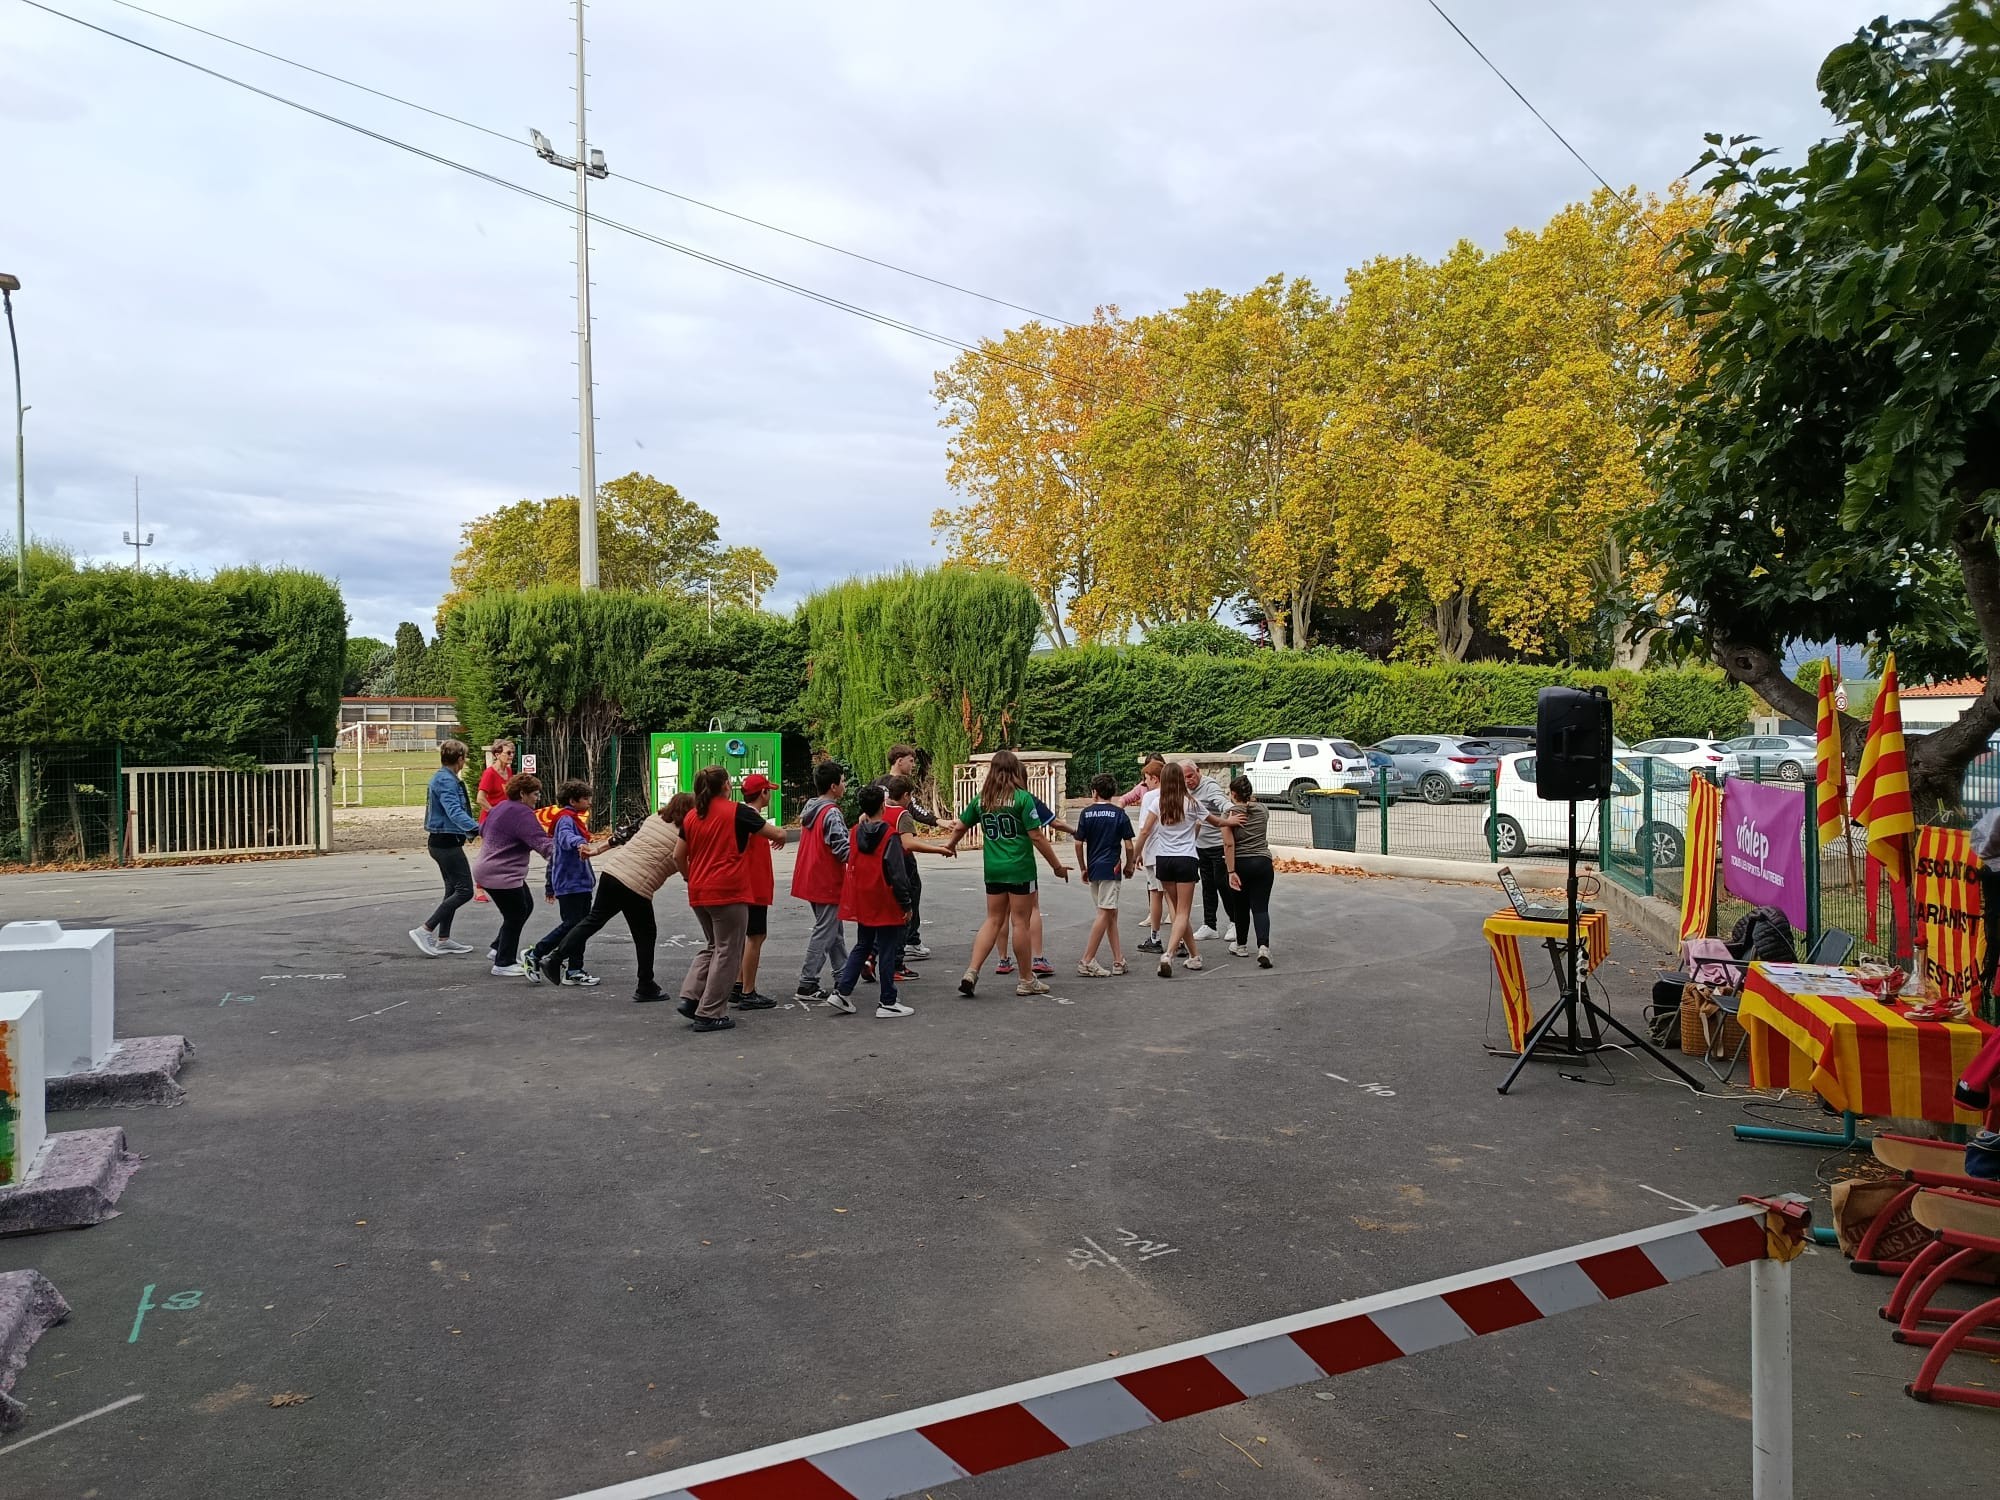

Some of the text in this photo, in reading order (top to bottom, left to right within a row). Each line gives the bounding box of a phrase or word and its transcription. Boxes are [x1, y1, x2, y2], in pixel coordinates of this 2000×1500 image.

[751, 767, 769, 775] TRIE
[981, 812, 1018, 841] 60
[1917, 902, 1984, 937] ARDANIST
